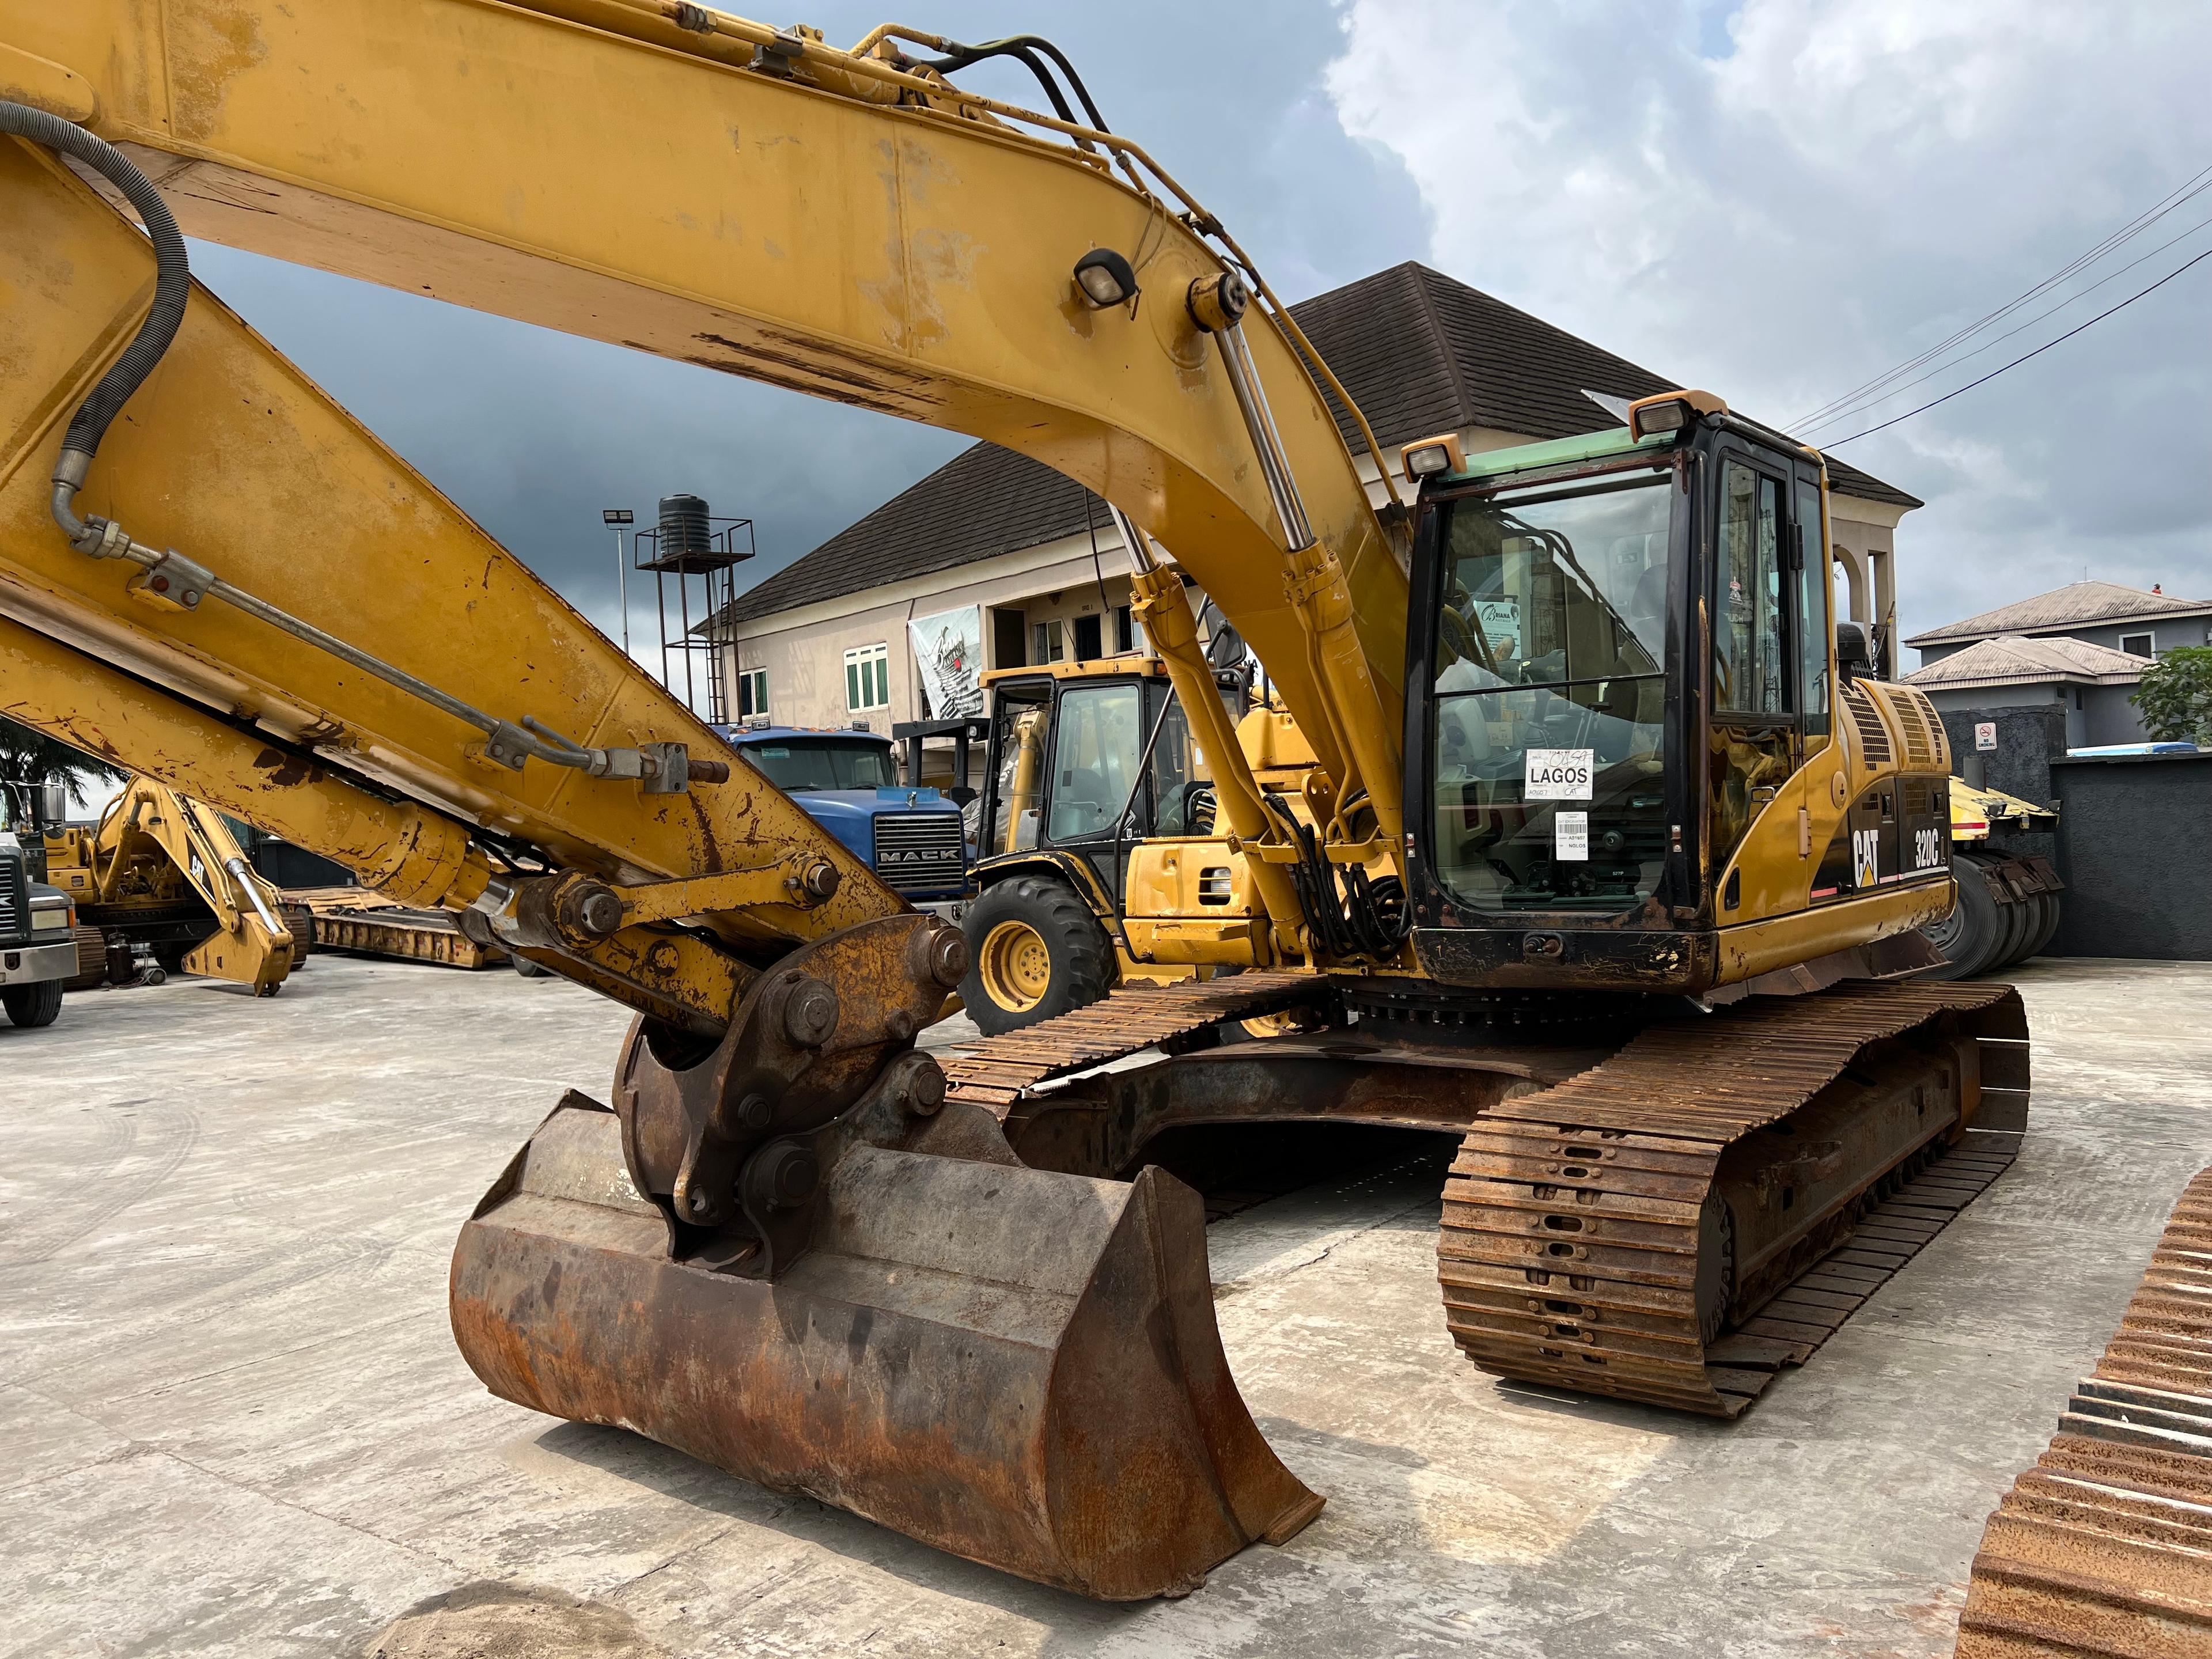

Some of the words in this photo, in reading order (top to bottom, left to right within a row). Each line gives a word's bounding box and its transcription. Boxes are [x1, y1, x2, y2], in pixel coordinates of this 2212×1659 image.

[1531, 768, 1588, 783] LAGOS
[1565, 787, 1580, 796] CAT
[880, 850, 958, 862] MACK
[1853, 829, 1878, 888] CAT
[1915, 828, 1939, 868] 320C
[192, 855, 204, 885] CAT
